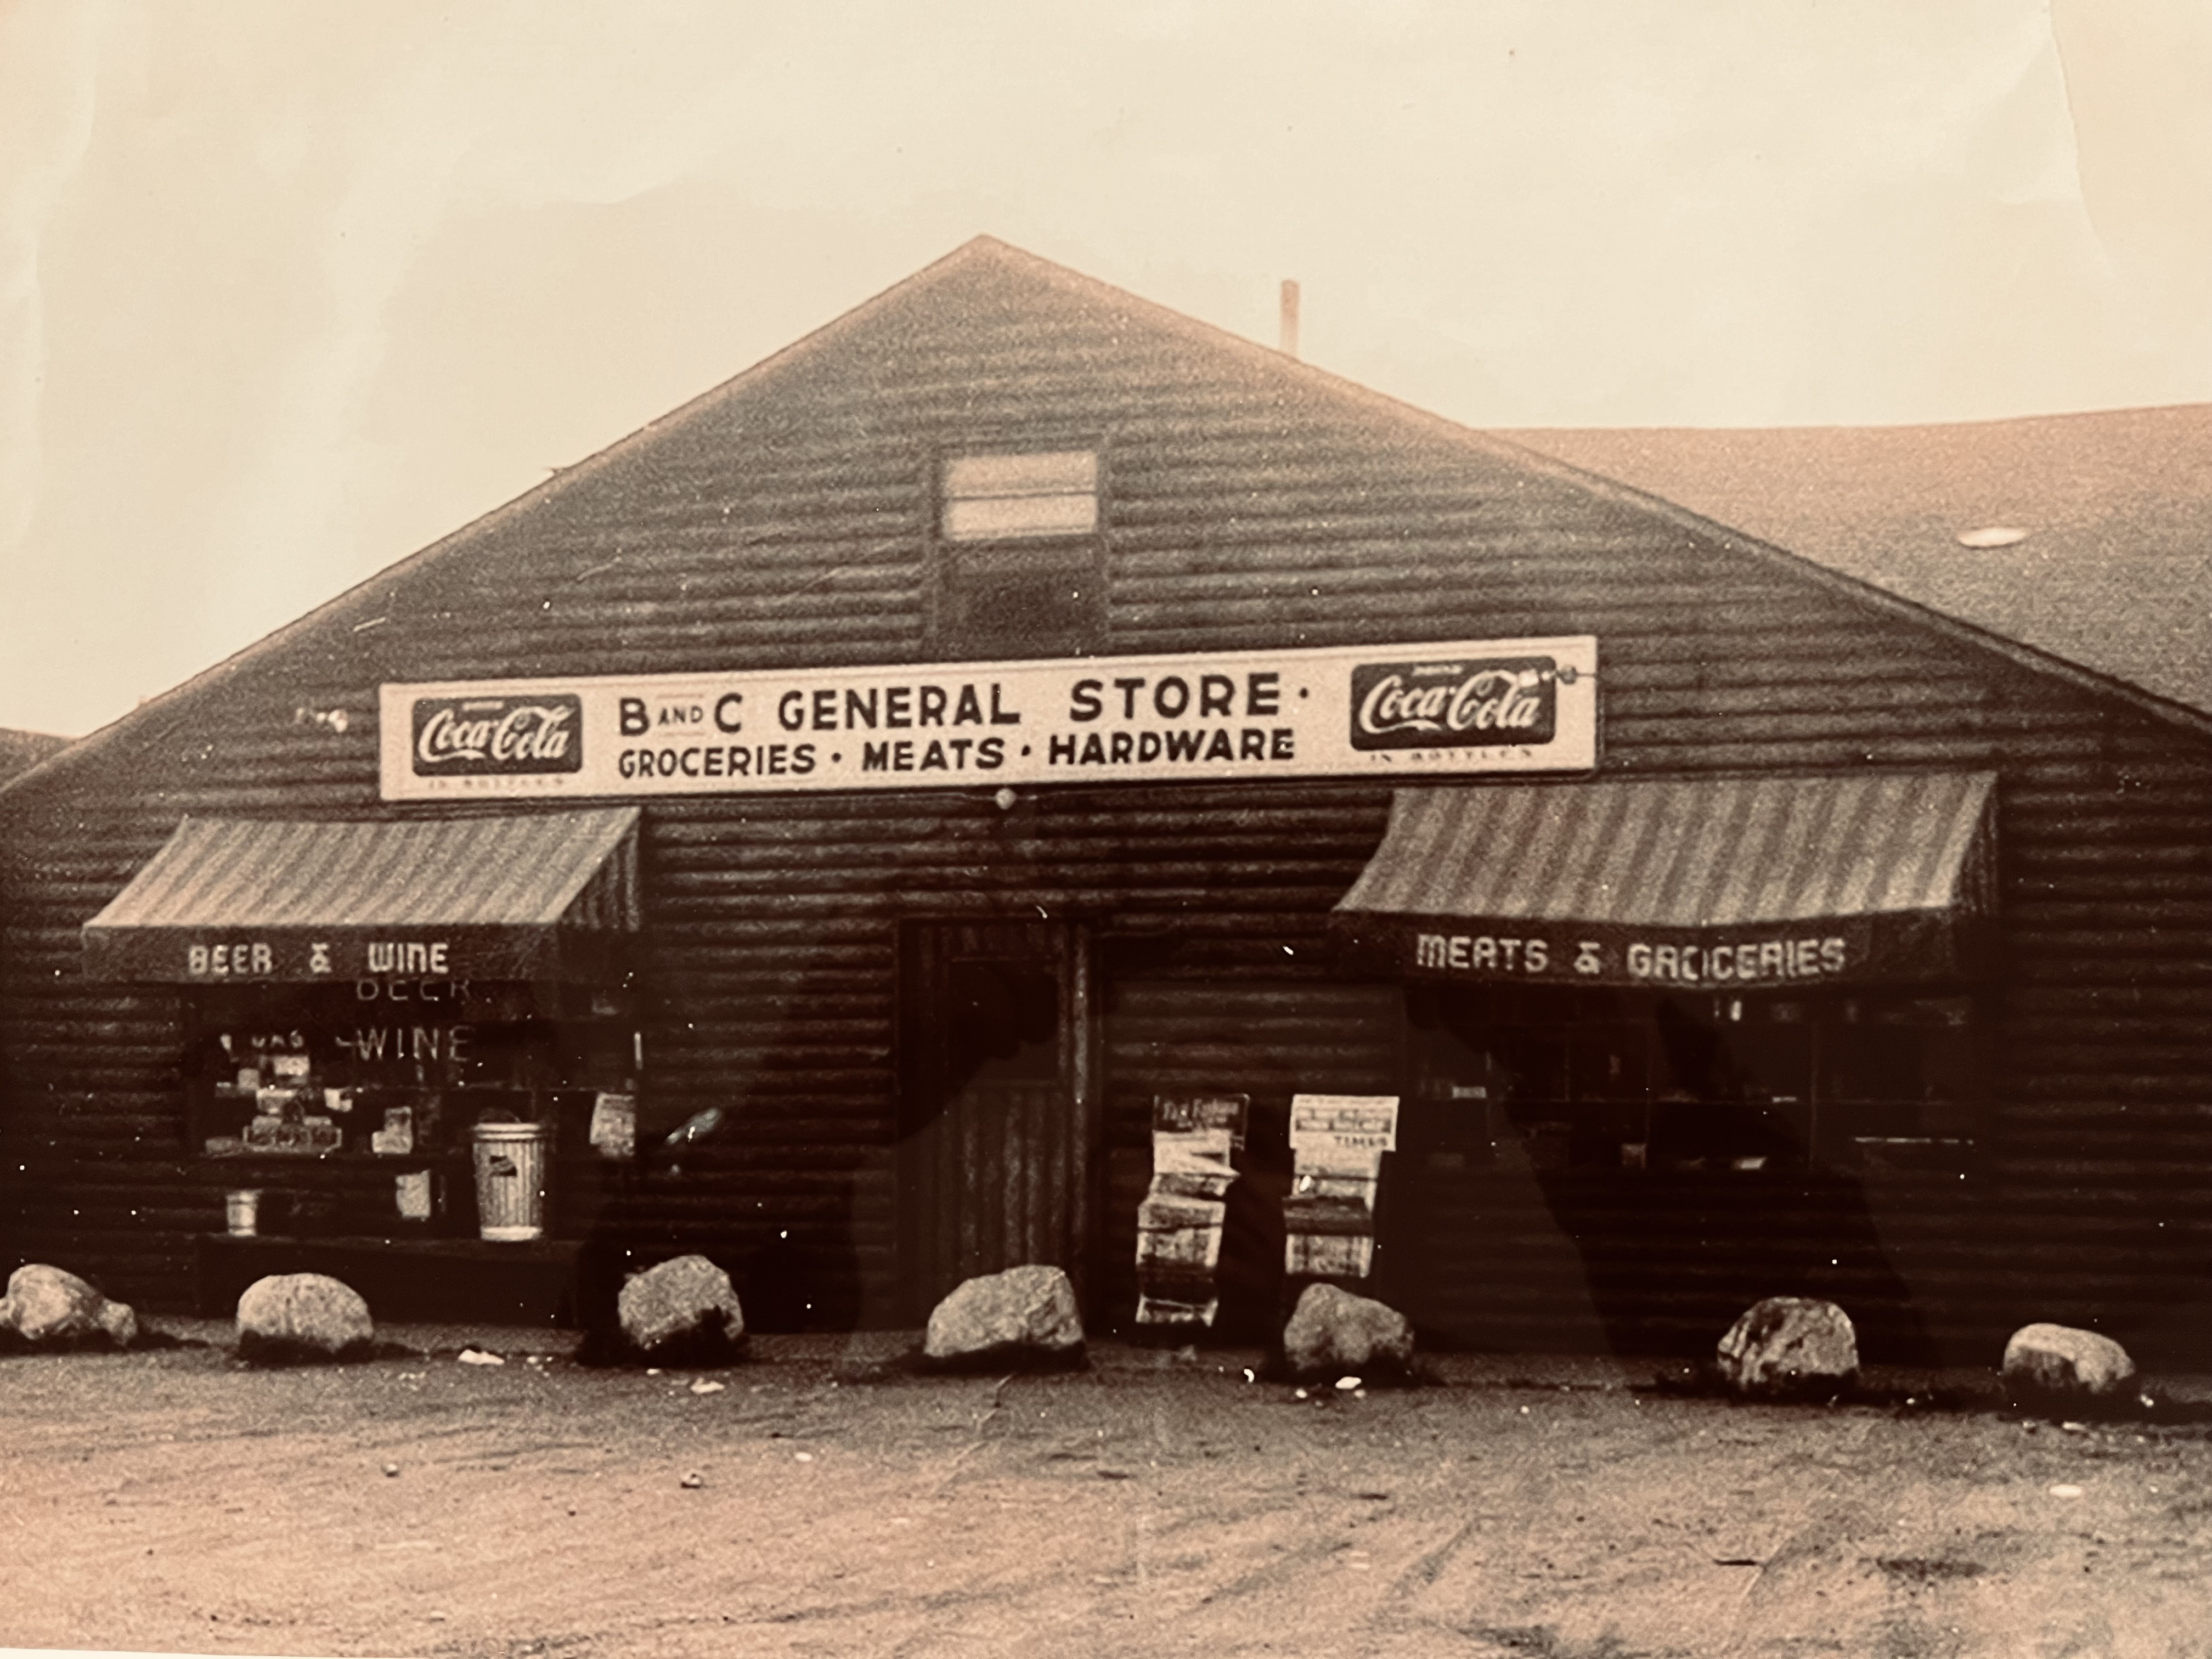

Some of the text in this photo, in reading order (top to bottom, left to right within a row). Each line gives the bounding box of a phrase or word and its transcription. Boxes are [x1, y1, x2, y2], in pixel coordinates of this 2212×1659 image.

[619, 673, 1279, 736] B AND C GENERAL STORE
[619, 729, 1294, 778] GROCERIES MEATS HARDWARE
[189, 943, 449, 975] BEER & WINE
[1418, 934, 1846, 980] MEATS & GROCERIES
[357, 1025, 473, 1062] WINE
